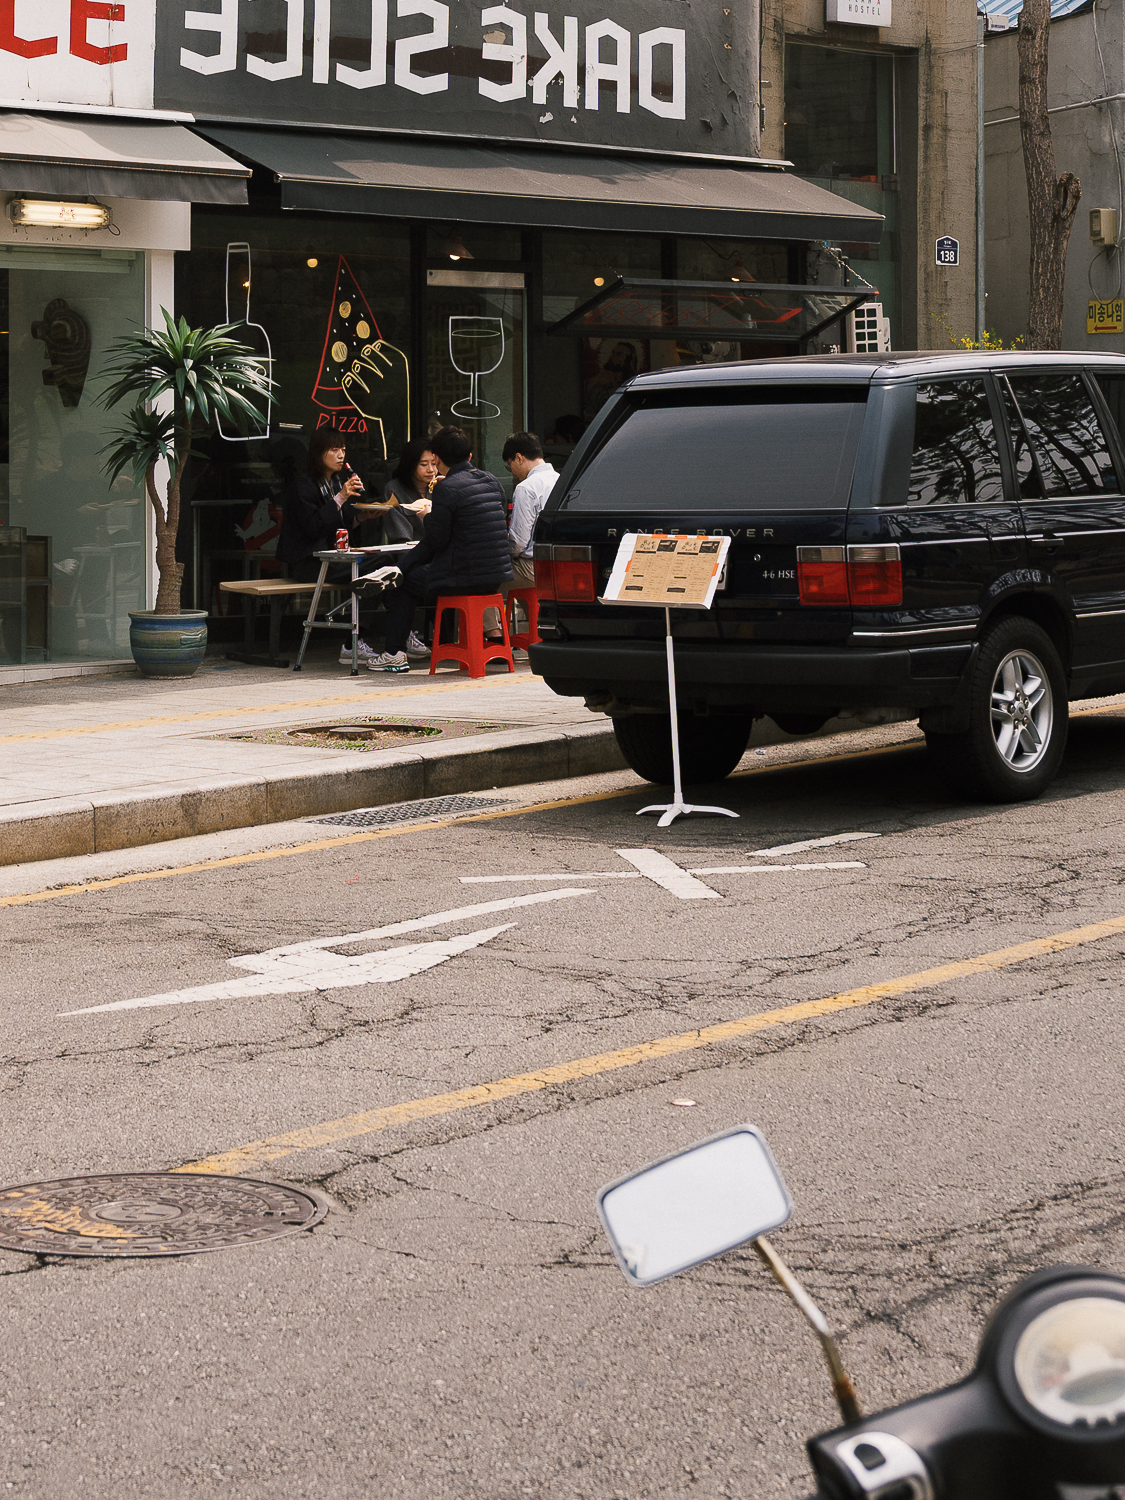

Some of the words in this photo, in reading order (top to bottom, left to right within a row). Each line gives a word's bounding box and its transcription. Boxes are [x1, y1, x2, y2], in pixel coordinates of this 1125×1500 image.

[848, 4, 881, 16] HOSTEL
[940, 250, 955, 262] 138
[1088, 303, 1122, 323] 미송나염
[607, 528, 680, 537] RANGE
[696, 528, 775, 537] ROVER
[778, 570, 795, 579] HSE
